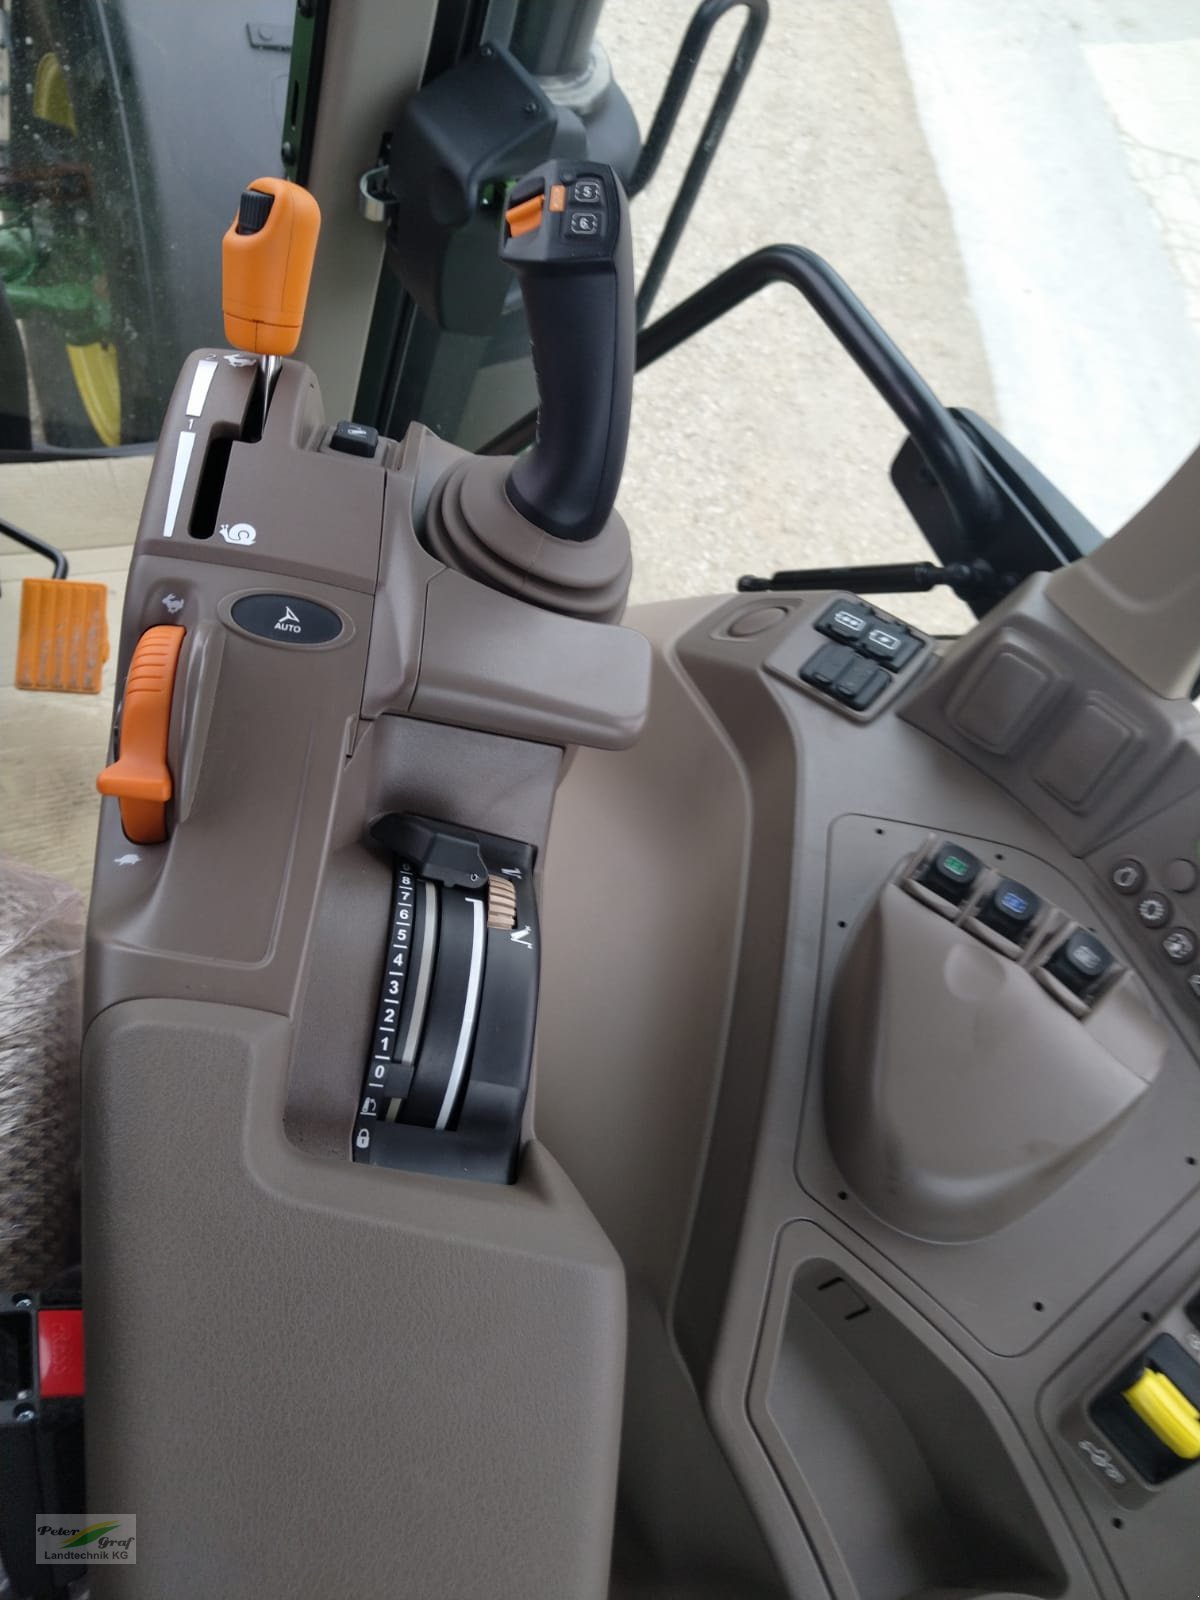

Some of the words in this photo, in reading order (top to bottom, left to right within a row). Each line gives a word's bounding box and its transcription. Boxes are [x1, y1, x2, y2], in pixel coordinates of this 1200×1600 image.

[188, 418, 194, 431] 1
[273, 622, 302, 634] AUTO
[401, 876, 411, 885] 8
[400, 891, 411, 901] 7
[399, 909, 409, 920] 6
[397, 929, 407, 941] 5
[392, 953, 403, 966] 4
[388, 980, 400, 995] 3
[383, 1008, 395, 1023] 2
[380, 1036, 389, 1051] 1
[374, 1064, 385, 1079] 0
